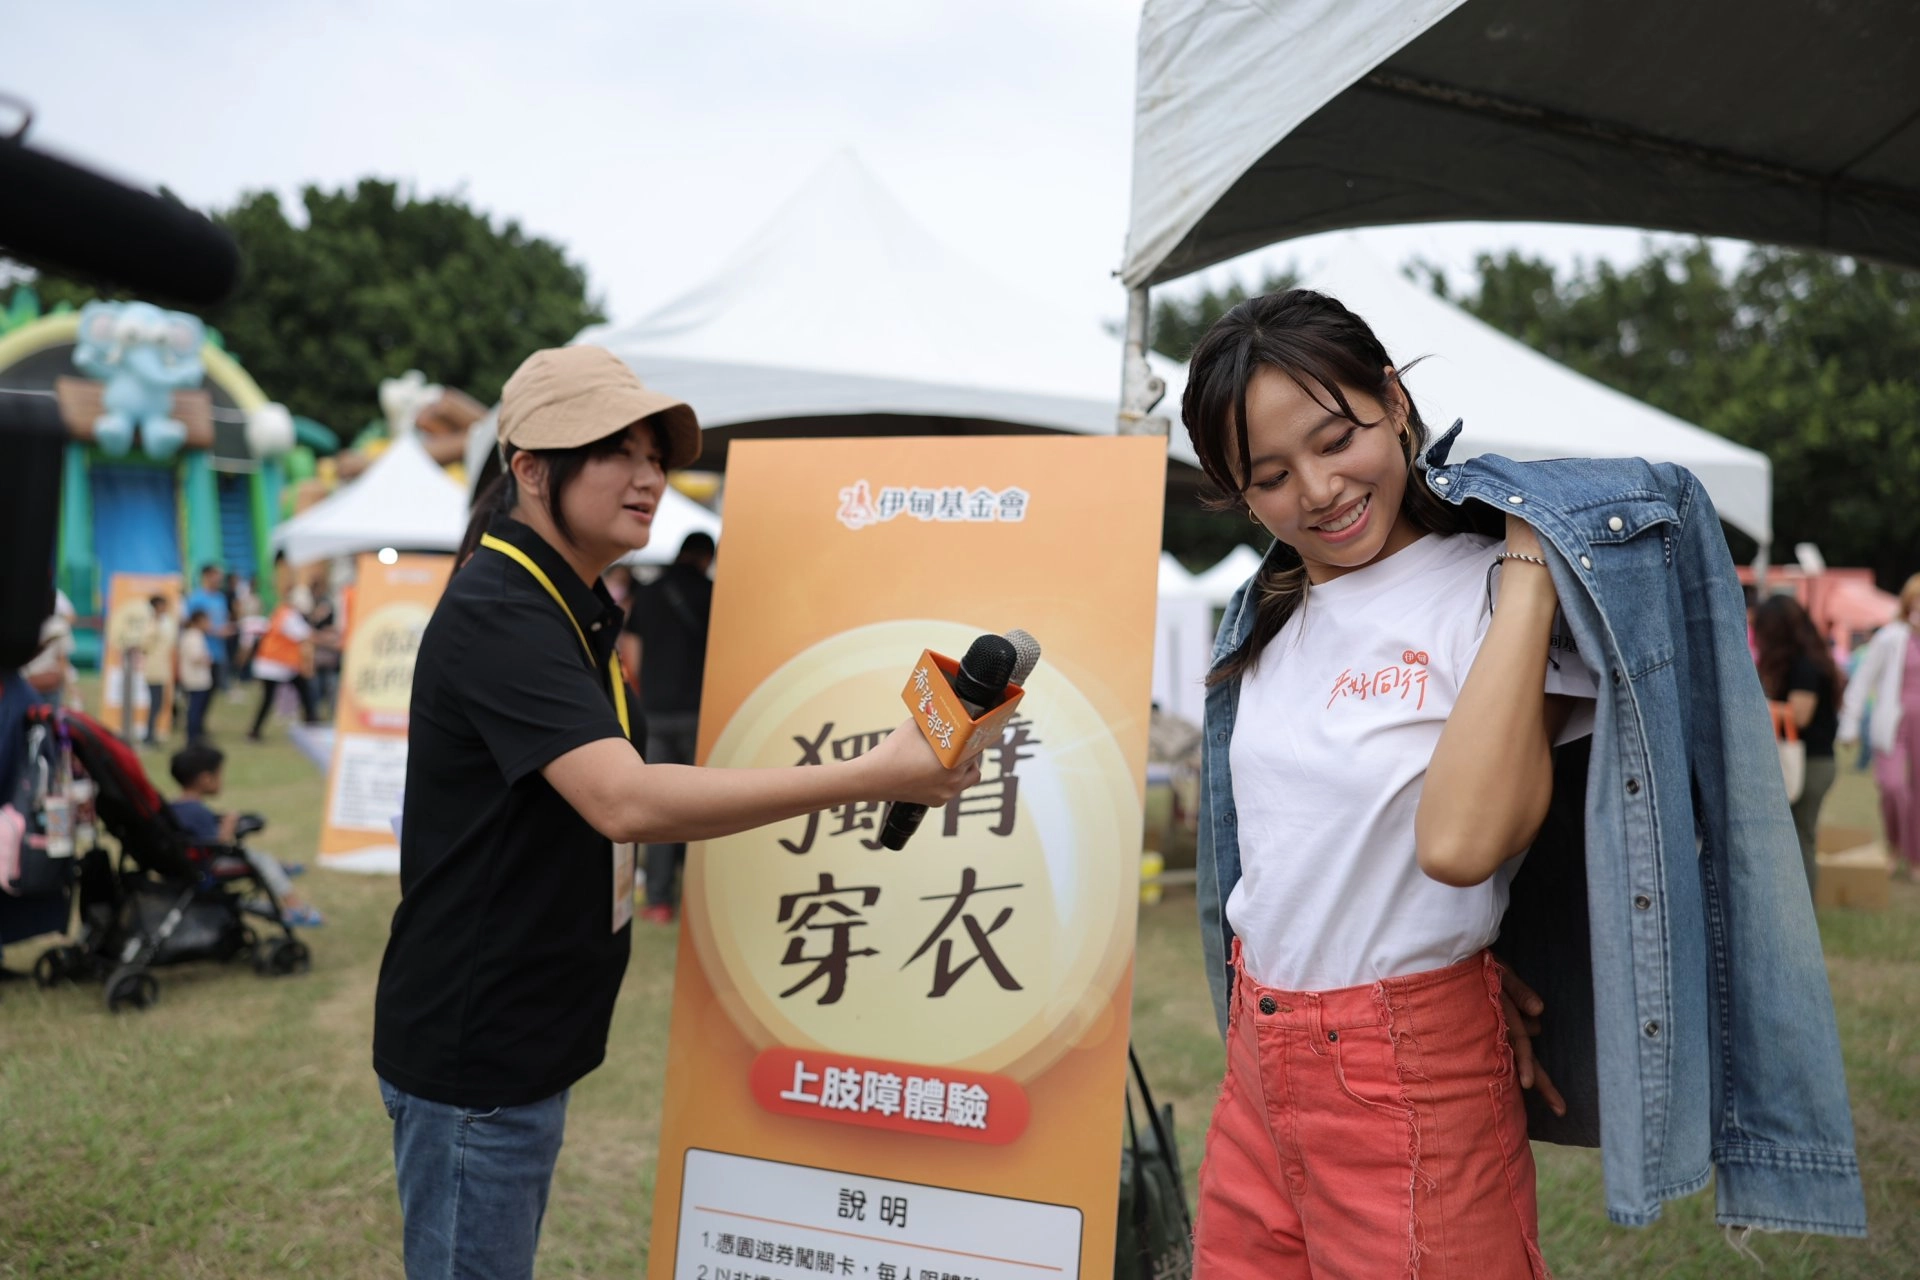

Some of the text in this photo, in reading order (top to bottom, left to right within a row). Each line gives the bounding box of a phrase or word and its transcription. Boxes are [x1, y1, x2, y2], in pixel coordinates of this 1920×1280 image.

[878, 487, 1027, 520] 伊甸基金會
[777, 867, 1024, 1006] 穿衣
[779, 1059, 990, 1130] 上肢障體驗
[837, 1187, 909, 1228] 說明
